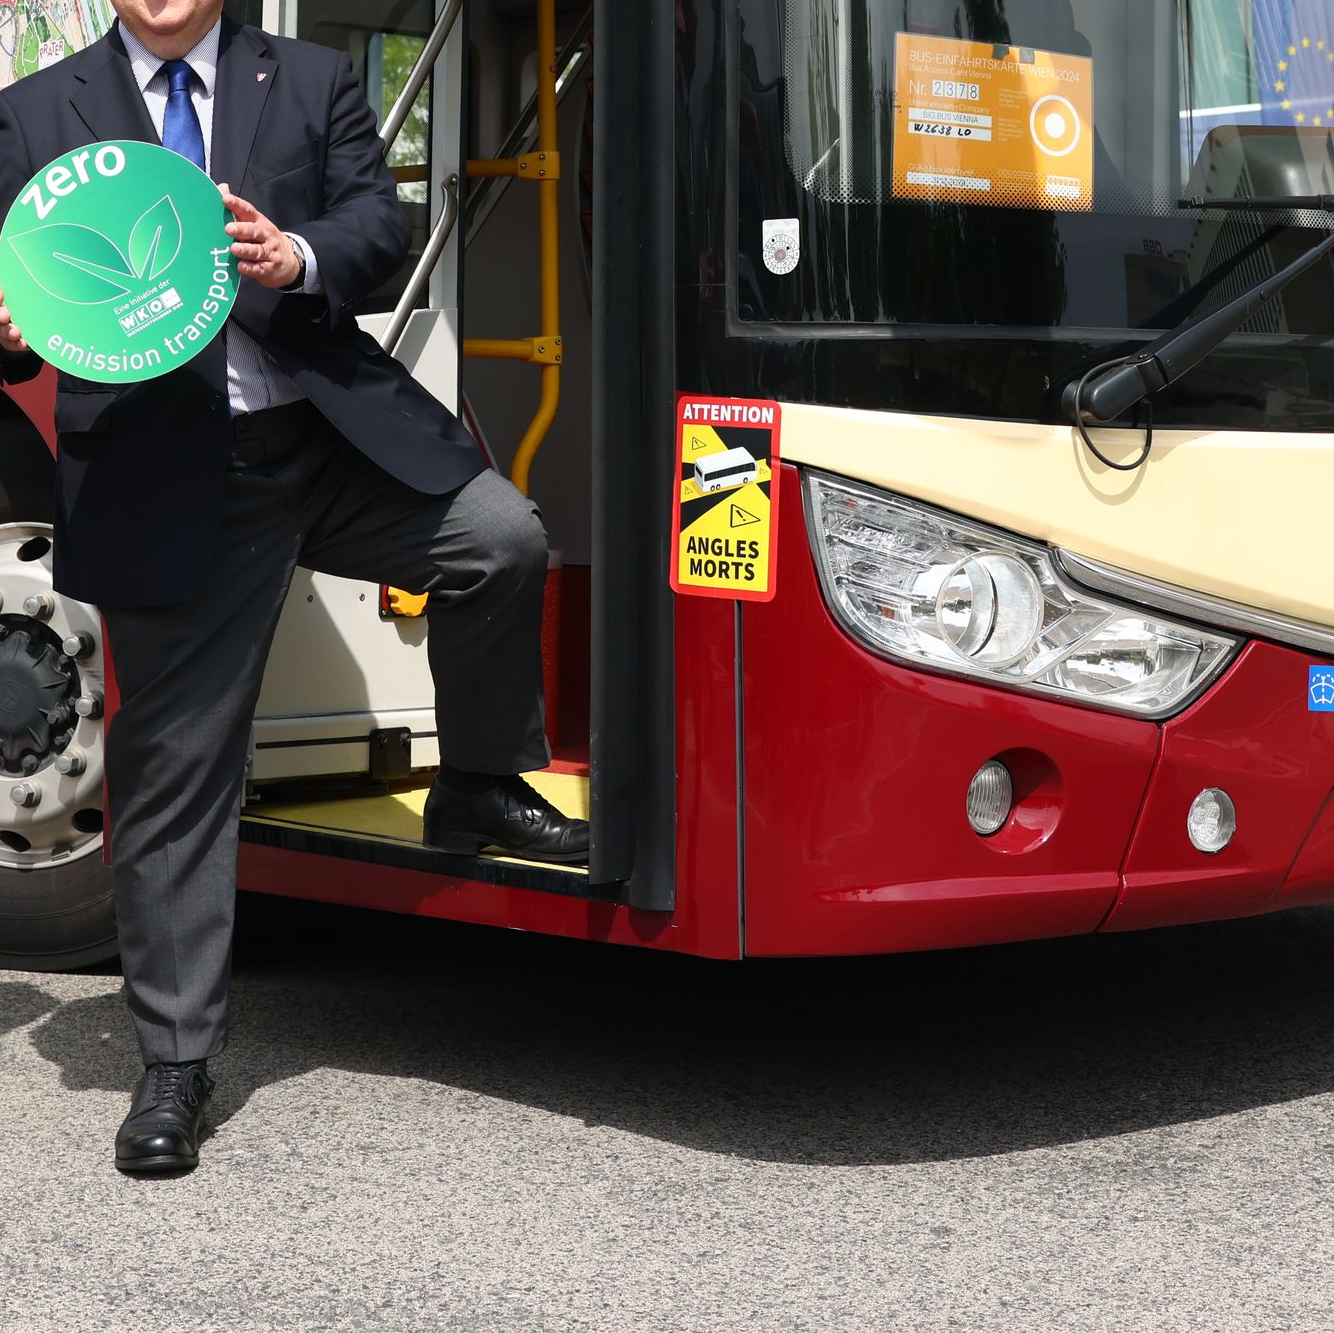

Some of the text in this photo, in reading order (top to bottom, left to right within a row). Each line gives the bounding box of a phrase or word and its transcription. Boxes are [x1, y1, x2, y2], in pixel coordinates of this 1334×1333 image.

[40, 40, 64, 59] PRATER
[909, 50, 1080, 83] BUS-EINFAHRTSKARTE WIEN 2024
[968, 71, 992, 80] Vienna
[909, 79, 927, 96] Nr.
[934, 81, 978, 99] 2378
[922, 111, 979, 123] BIG BUS VIENNA
[957, 128, 972, 136] LO
[20, 145, 126, 220] zero
[47, 333, 161, 372] emission
[164, 246, 231, 356] transport
[113, 302, 130, 315] Eine
[129, 286, 158, 306] Initiative
[120, 299, 163, 330] WKO
[683, 403, 774, 424] ATTENTION
[686, 536, 759, 559] ANGLES
[689, 558, 755, 581] MORTS
